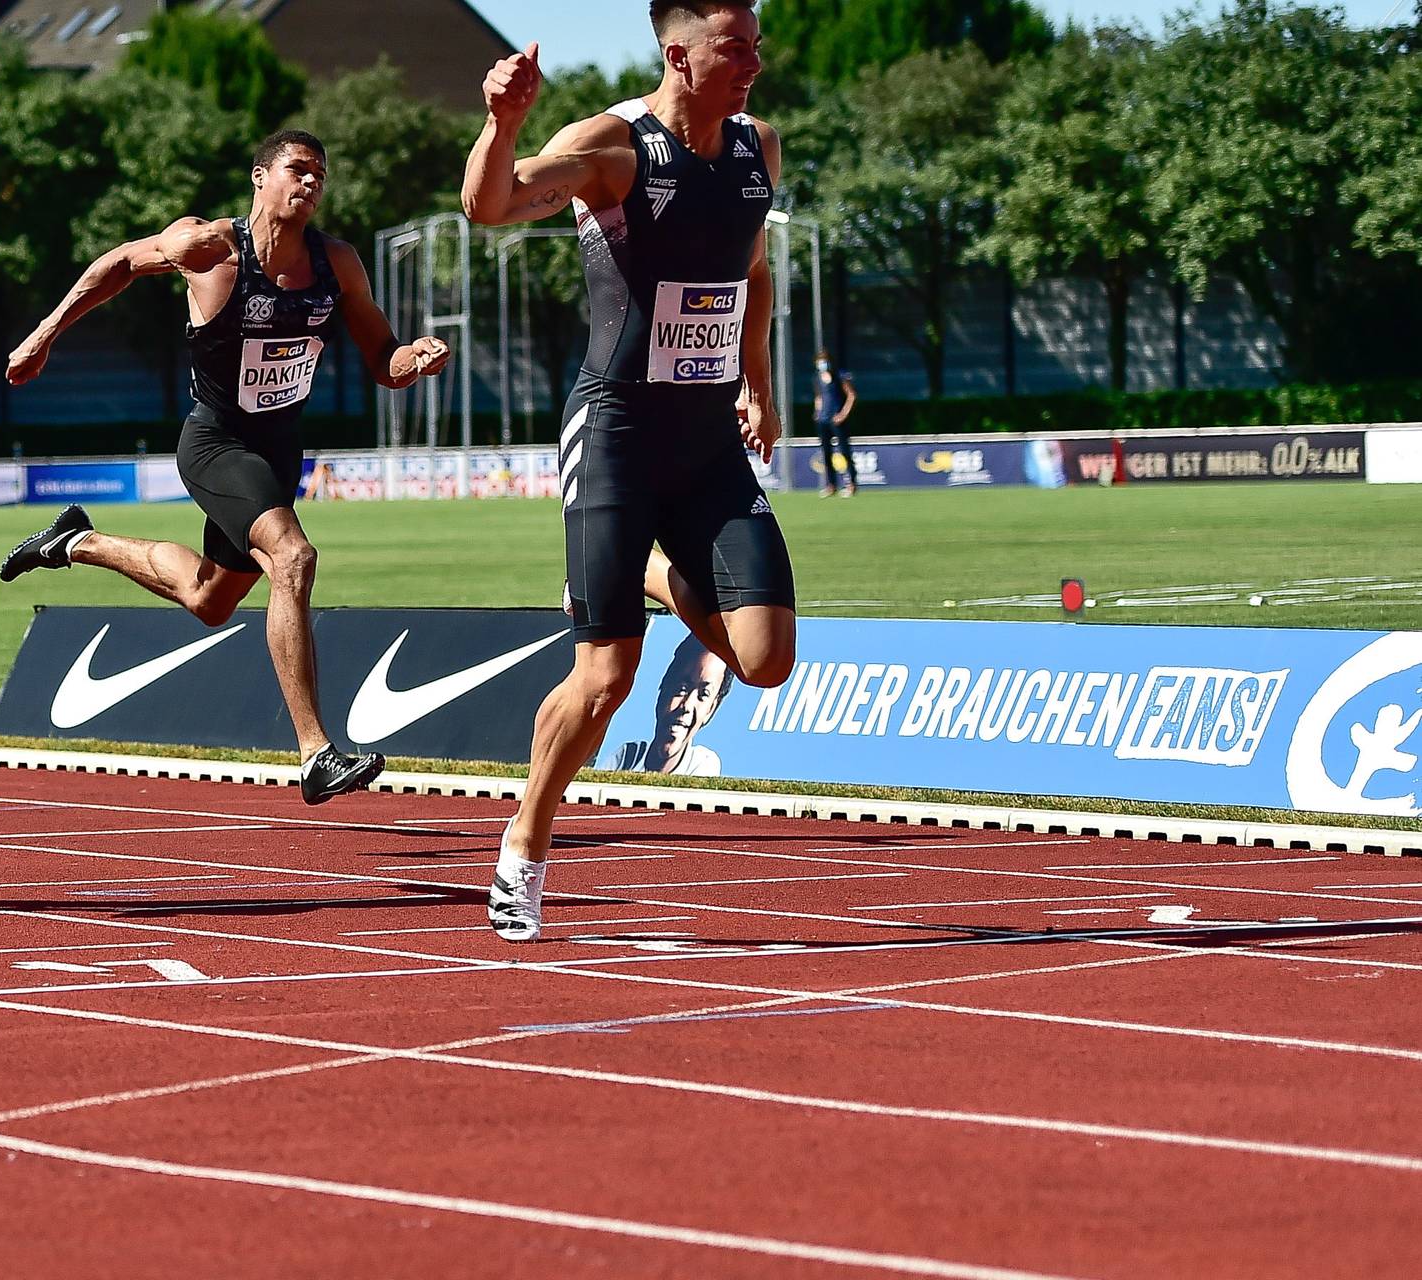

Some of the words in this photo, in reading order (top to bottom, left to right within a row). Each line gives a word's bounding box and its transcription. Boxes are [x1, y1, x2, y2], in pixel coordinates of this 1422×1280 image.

[647, 178, 677, 187] TREC
[248, 299, 273, 318] 96
[713, 294, 734, 309] GLS
[657, 320, 741, 350] WIESOLEK
[287, 343, 305, 357] GLS
[244, 353, 315, 387] DIAKITÉ
[697, 360, 724, 373] PLAN
[276, 387, 298, 400] PLAN
[1172, 452, 1202, 477] IST
[748, 661, 910, 737] KINDER
[898, 666, 1139, 748] BRAUCHEN
[1130, 675, 1278, 753] FANS!
